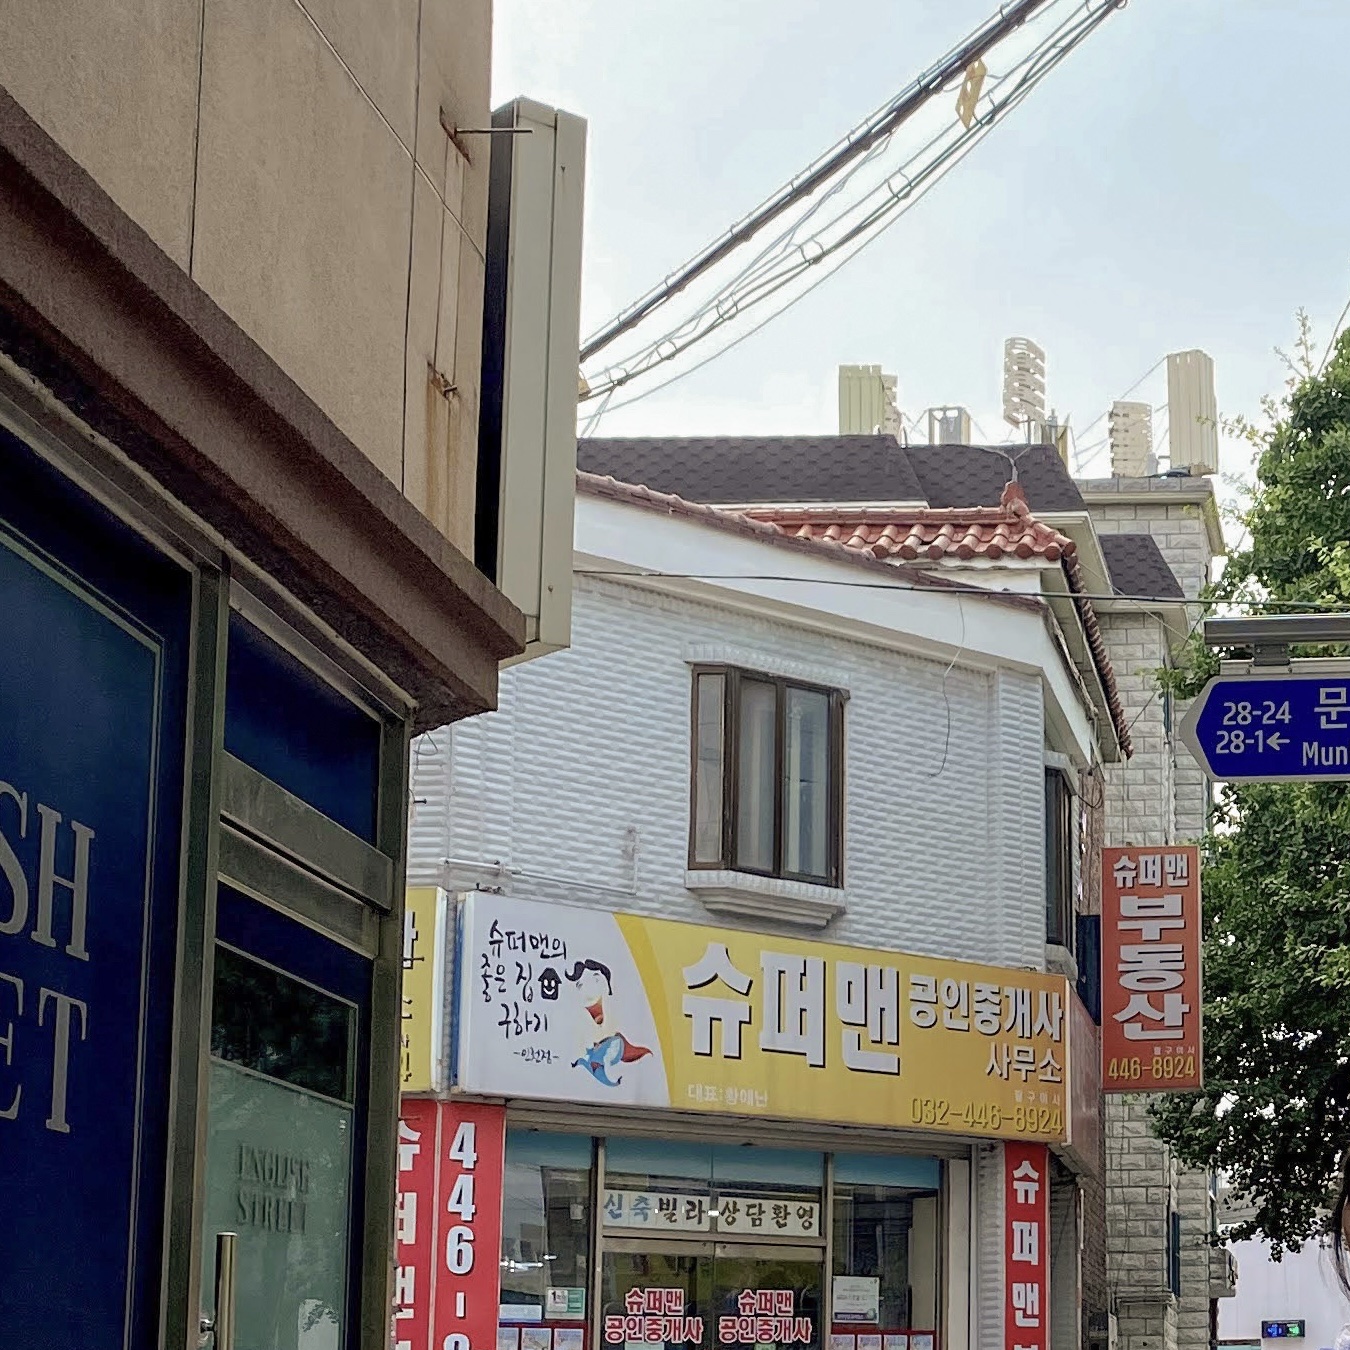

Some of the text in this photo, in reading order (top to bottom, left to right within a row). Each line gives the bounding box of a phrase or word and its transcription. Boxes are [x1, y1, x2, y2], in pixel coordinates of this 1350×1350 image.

[1222, 702, 1292, 726] 28-24
[1216, 730, 1264, 754] 28-1
[1113, 854, 1190, 888] 슈퍼맨
[489, 919, 566, 960] 슈퍼맨의
[481, 953, 534, 1002] 좋은 집
[1112, 894, 1191, 1041] 부동산
[498, 1001, 548, 1039] 구하기
[682, 943, 1066, 1075] 슈퍼맨 공인중개사
[985, 1041, 1063, 1083] 사무소
[1108, 1055, 1196, 1081] 446-8924
[911, 1098, 1064, 1135] 032-446-8924
[625, 1288, 685, 1316] 슈퍼맨
[738, 1289, 794, 1317] 슈퍼맨
[605, 1315, 704, 1344] 공인중개사
[719, 1316, 812, 1344] 공인중개사
